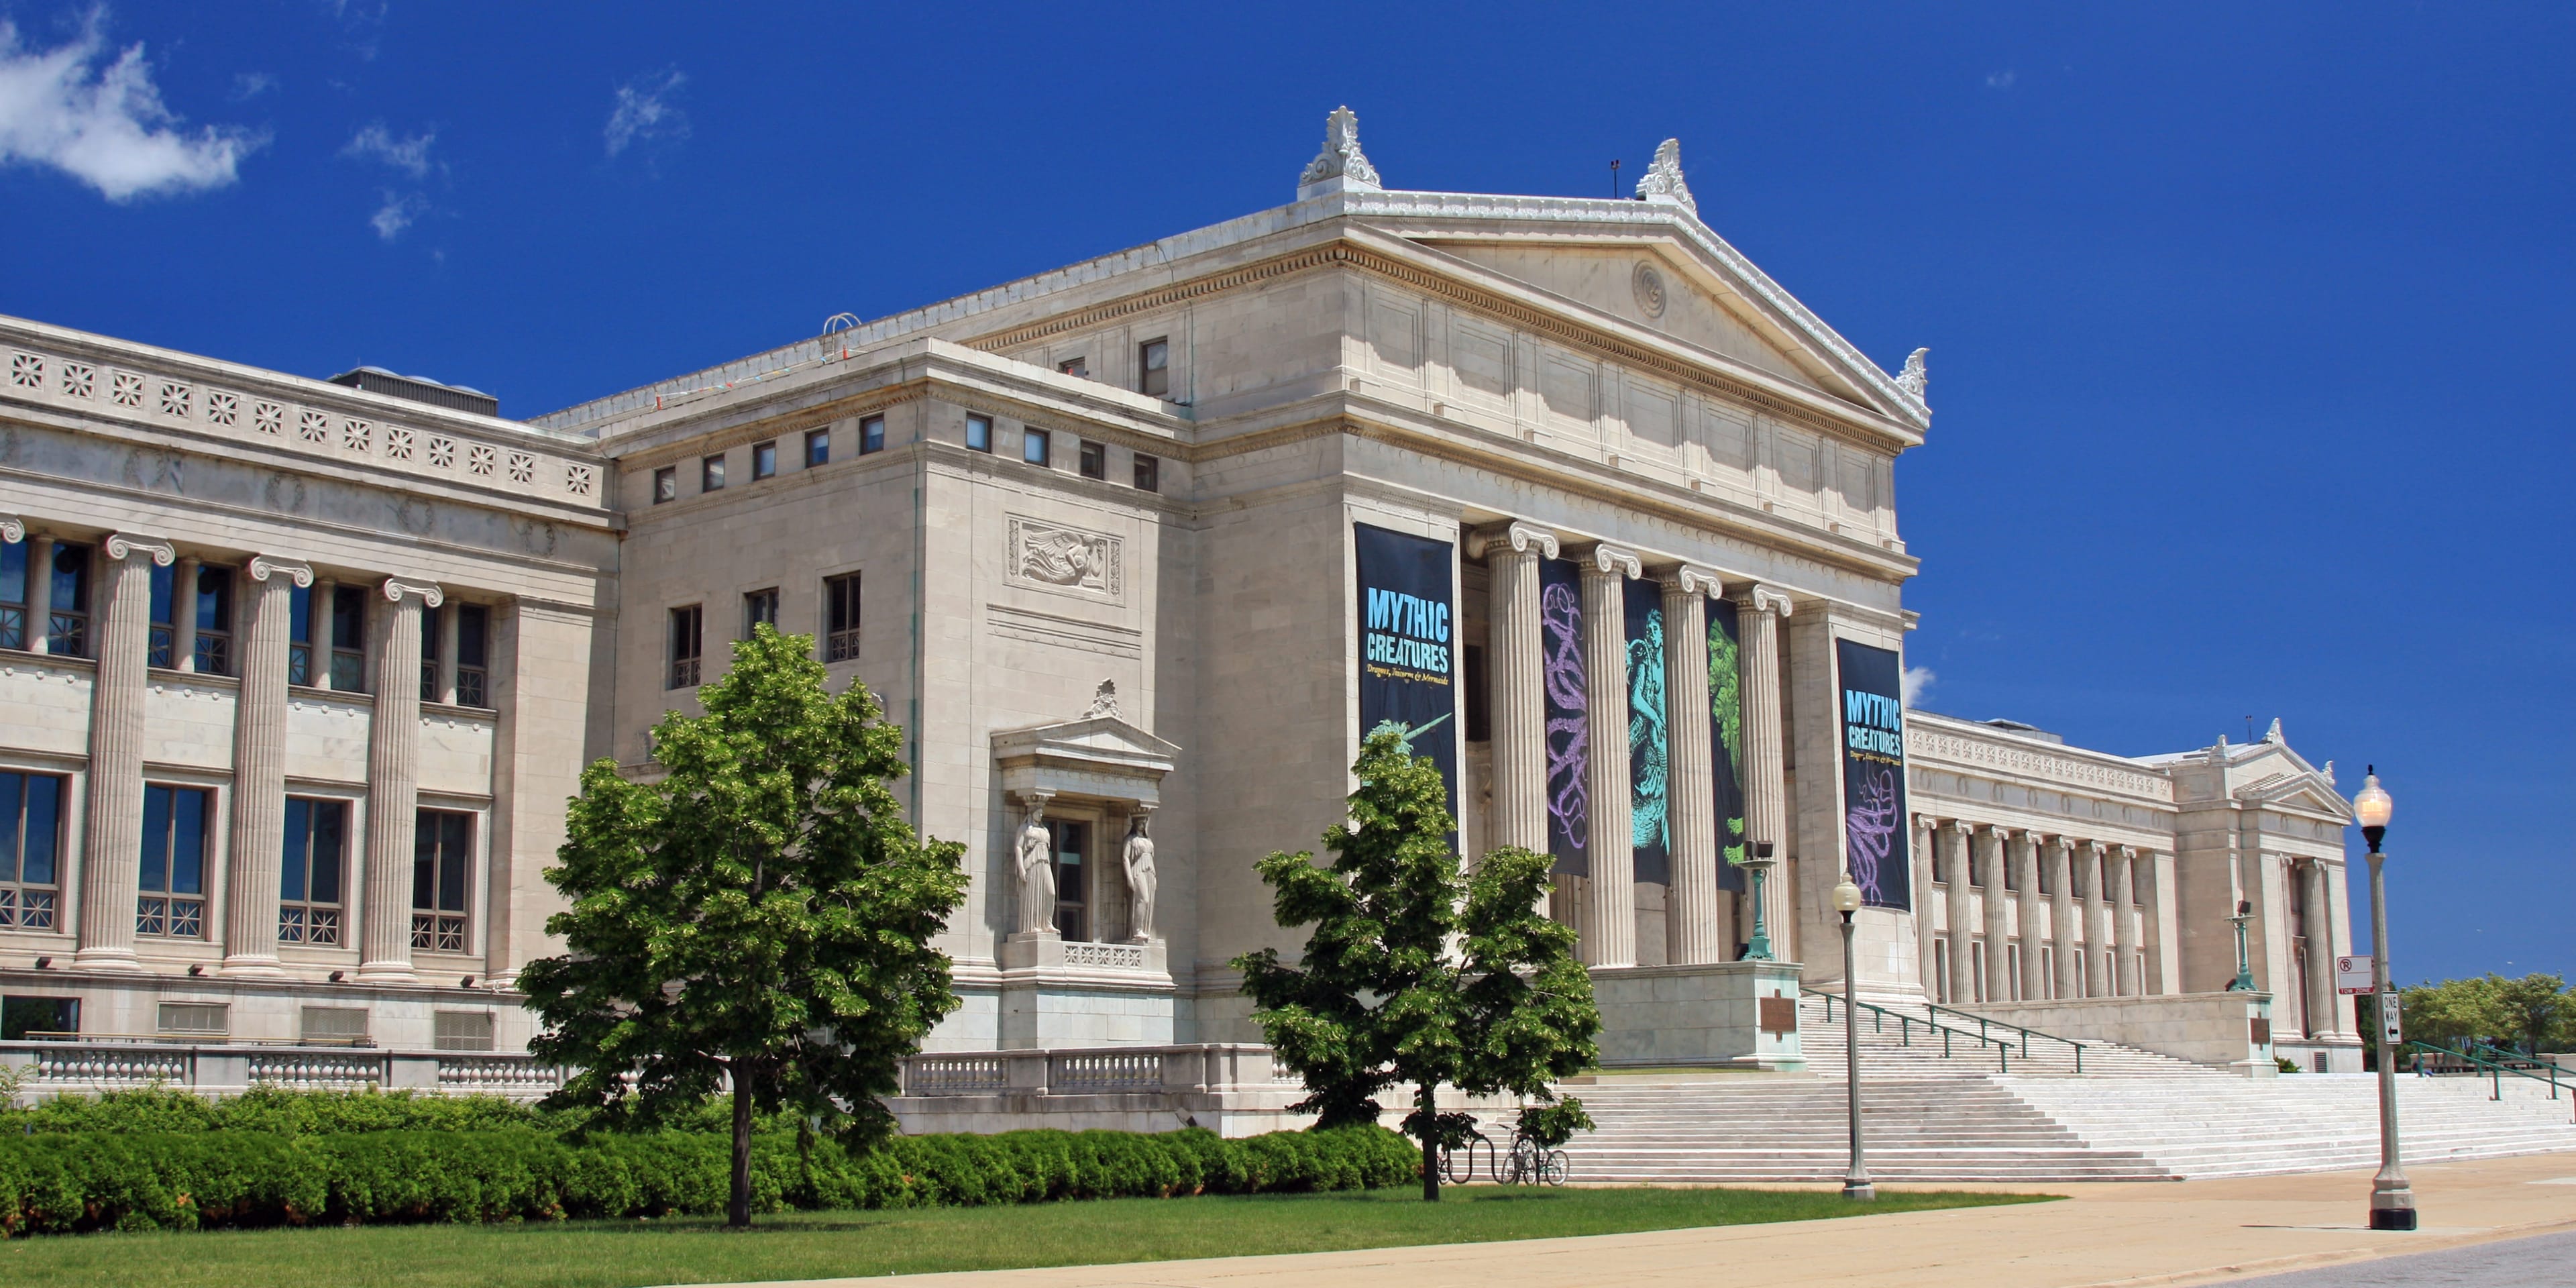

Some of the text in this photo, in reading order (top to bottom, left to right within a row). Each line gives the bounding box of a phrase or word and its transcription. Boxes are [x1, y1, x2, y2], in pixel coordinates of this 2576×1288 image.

[1368, 587, 1448, 643] MYTHIC
[1366, 633, 1448, 674] CREATURES
[1414, 672, 1421, 681] &
[1846, 690, 1900, 732] MYTHIC
[1848, 725, 1900, 757] CREATURES
[2384, 996, 2397, 1008] ONE
[2385, 1011, 2398, 1022] WAY
